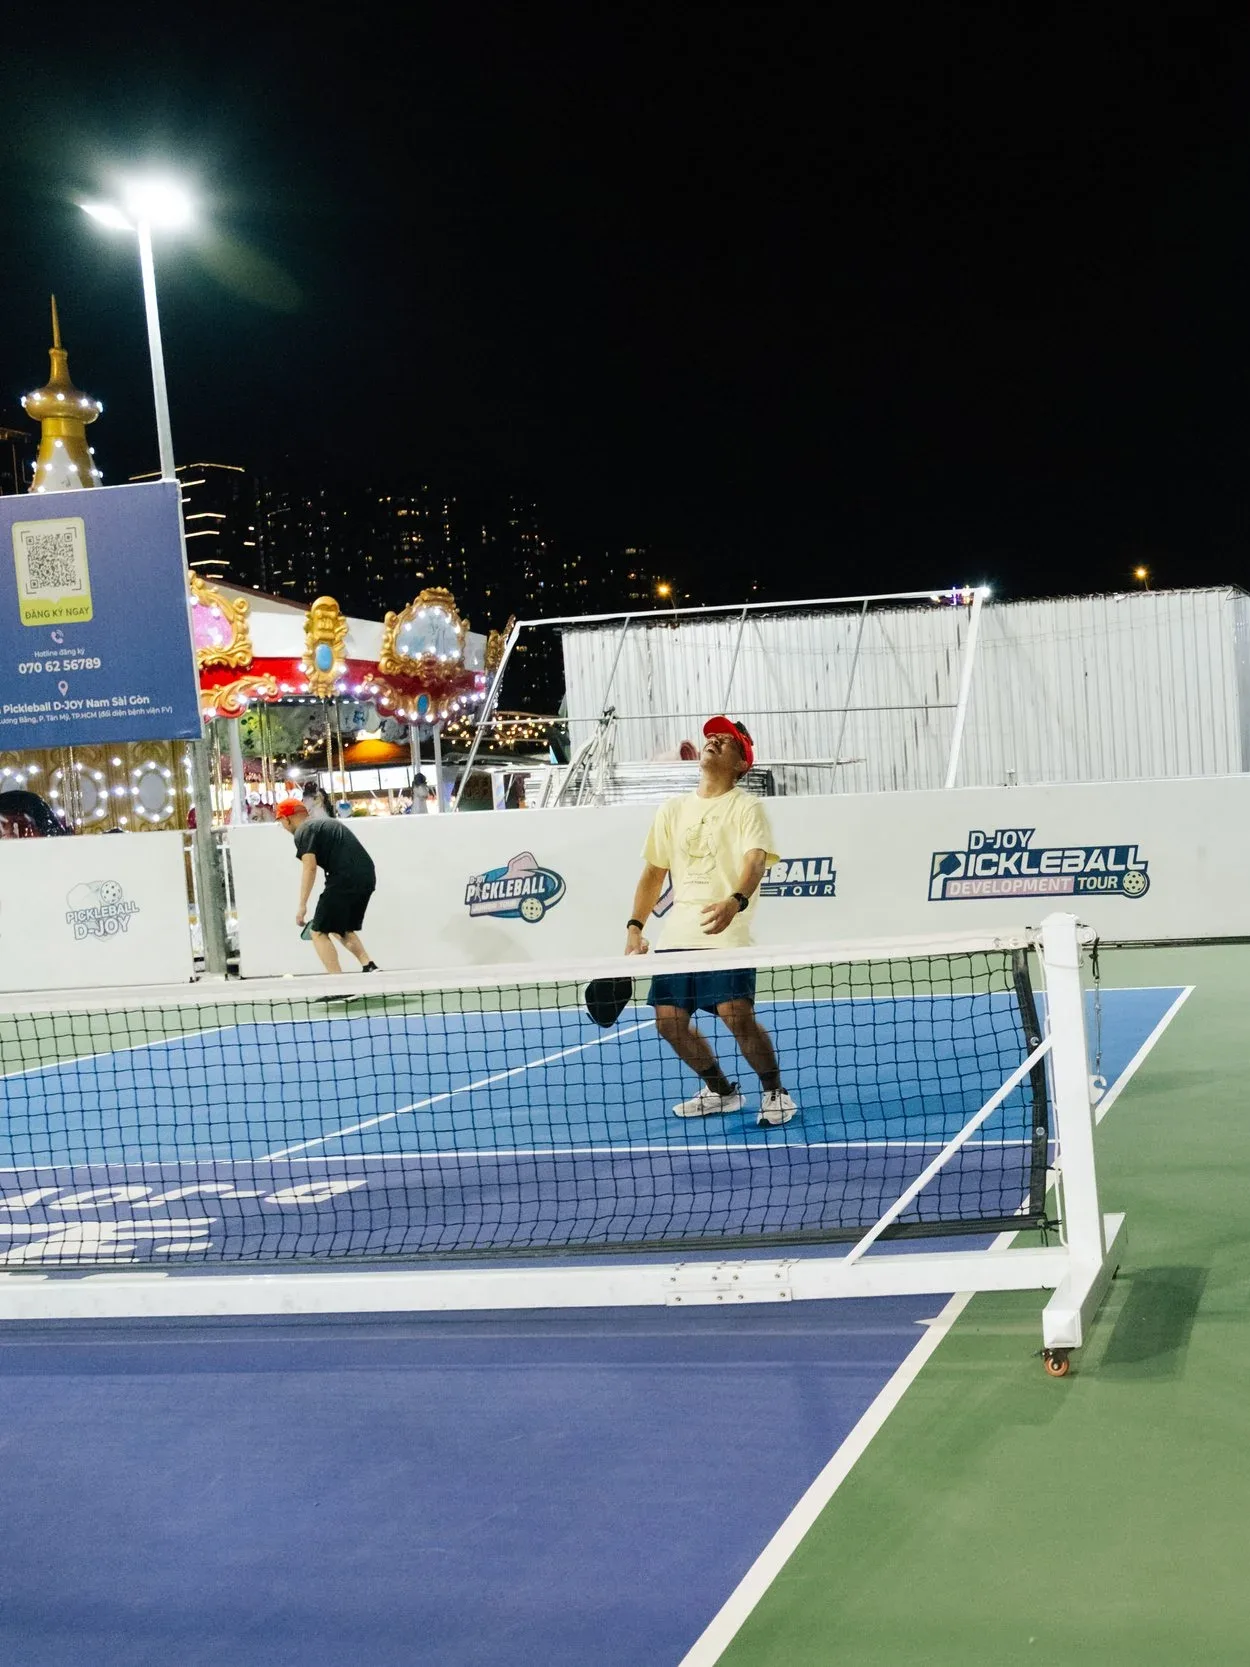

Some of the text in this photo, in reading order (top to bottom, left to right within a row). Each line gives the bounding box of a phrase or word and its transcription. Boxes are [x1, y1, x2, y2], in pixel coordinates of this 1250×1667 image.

[25, 605, 90, 619] ĐĂNG KÝ NGAY
[34, 649, 58, 658] Hotline
[59, 648, 76, 657] đăng
[18, 657, 101, 674] 070 62 56789
[3, 695, 150, 714] Pickleball D-JOY Nam Sài Gòn
[970, 830, 1033, 849] D-JOY
[931, 847, 1146, 899] PICKLEBALL
[780, 885, 834, 896] TOUR
[949, 876, 1118, 896] DEVELOPMENT TOUR
[65, 900, 140, 924] PICKLEBALL
[74, 915, 131, 940] D-JOY
